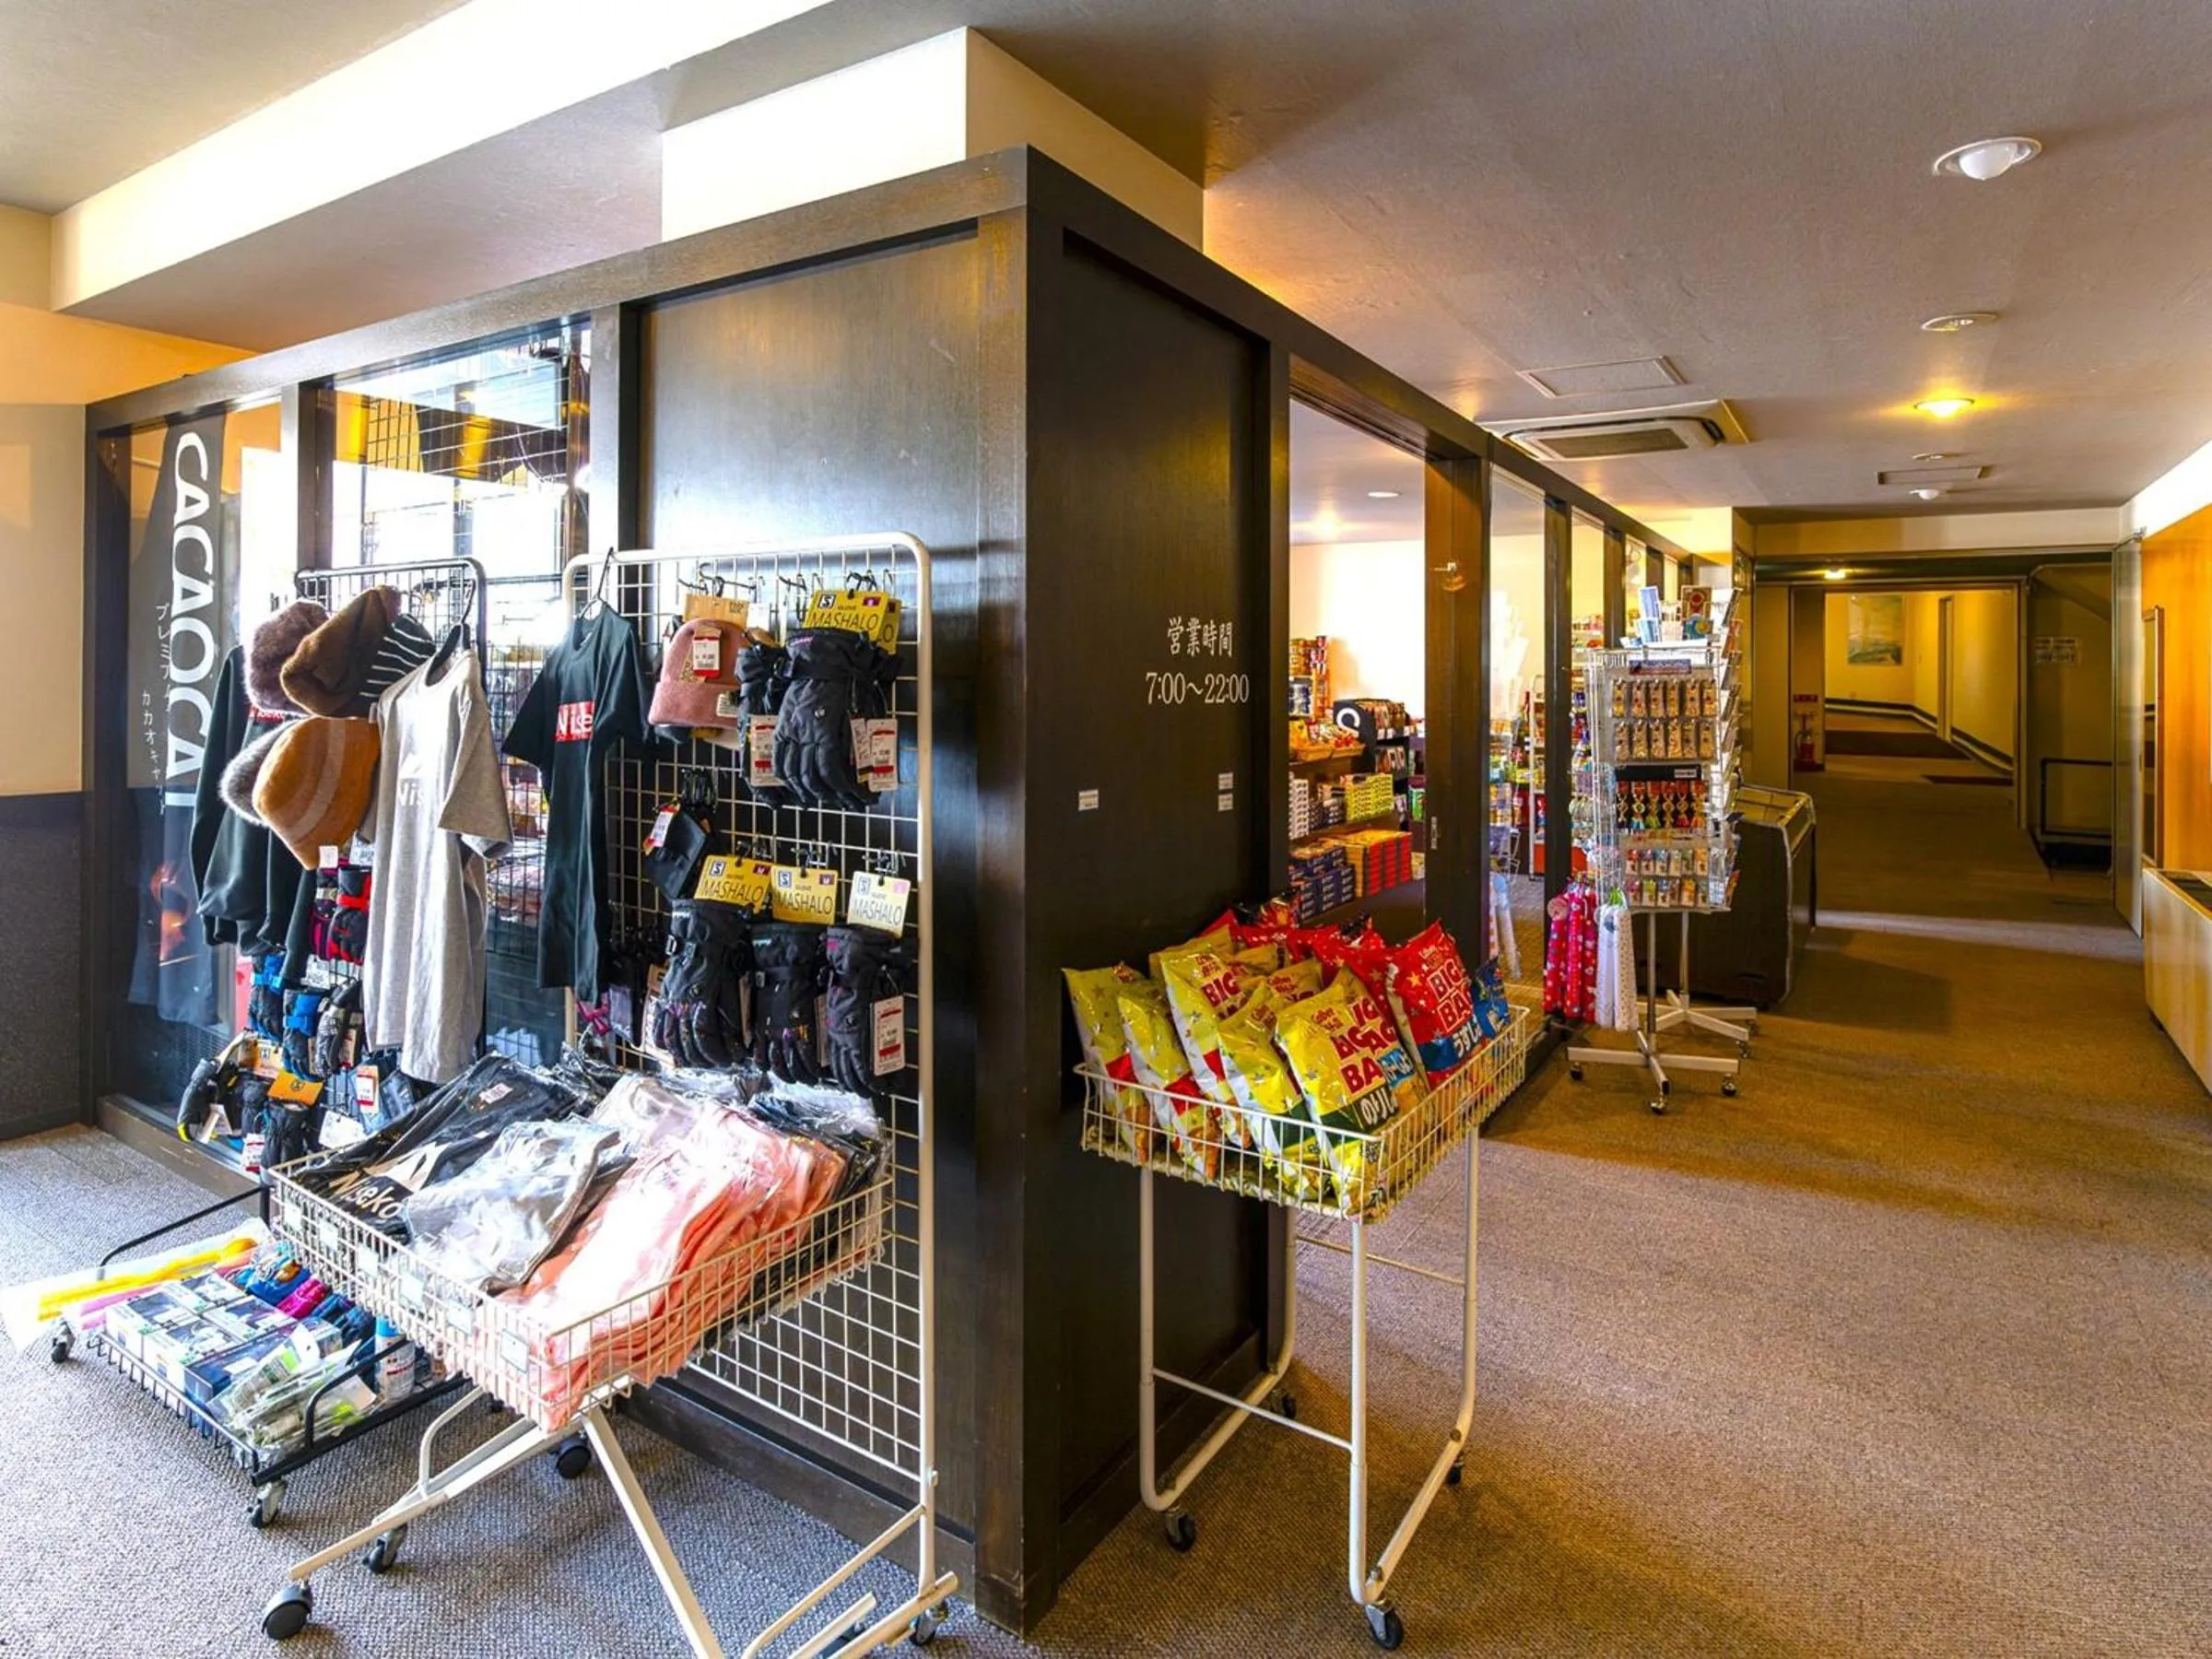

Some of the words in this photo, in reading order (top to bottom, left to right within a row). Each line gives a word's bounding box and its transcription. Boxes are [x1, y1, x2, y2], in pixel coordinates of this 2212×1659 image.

[809, 611, 878, 630] MASHALO
[1167, 616, 1233, 658] 営業時間
[701, 879, 764, 903] MASHALO
[778, 890, 833, 915] MASHALO
[853, 898, 903, 924] MASHALO
[1201, 971, 1241, 1007] BIG
[1427, 959, 1465, 1002] BIG
[1351, 997, 1381, 1028] IG
[1359, 1087, 1397, 1125] のりし
